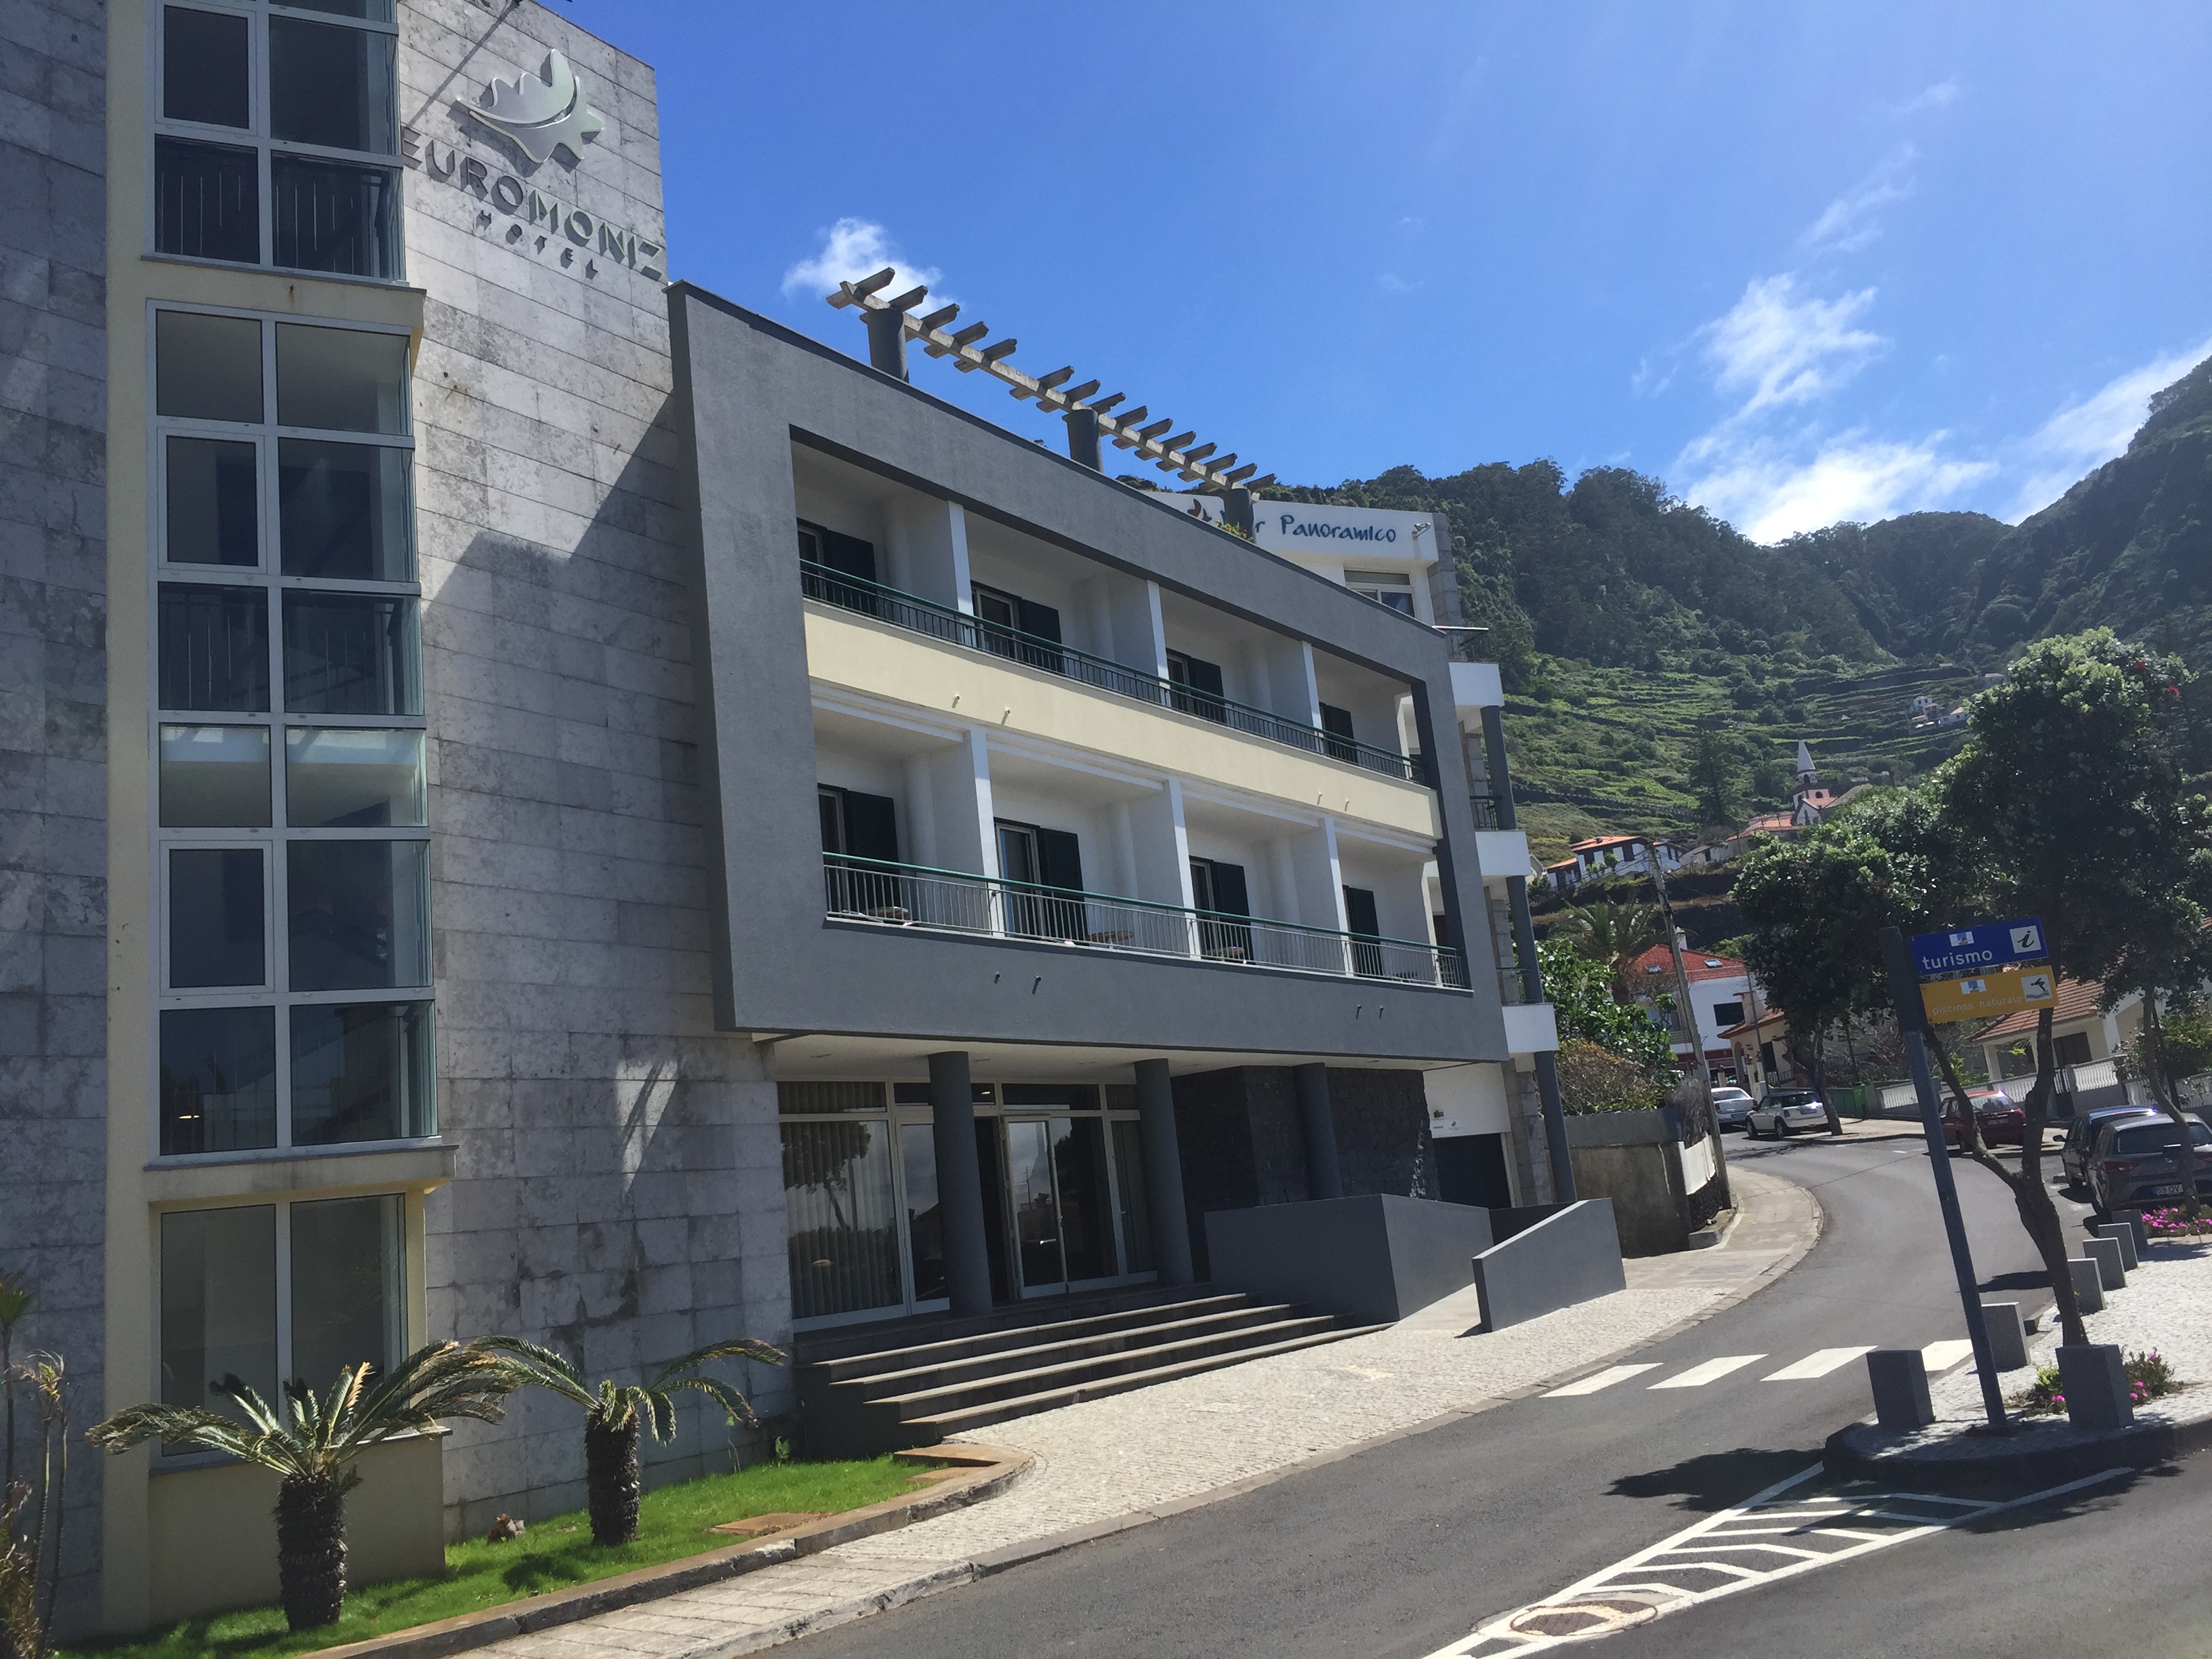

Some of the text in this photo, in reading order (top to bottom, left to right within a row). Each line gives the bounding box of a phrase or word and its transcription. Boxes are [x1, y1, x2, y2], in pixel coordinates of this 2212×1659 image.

[401, 125, 663, 281] EUROMONIZ
[476, 209, 599, 279] HOTEL
[1922, 949, 1993, 970] turismo
[1932, 996, 2022, 1017] piscinas naturais
